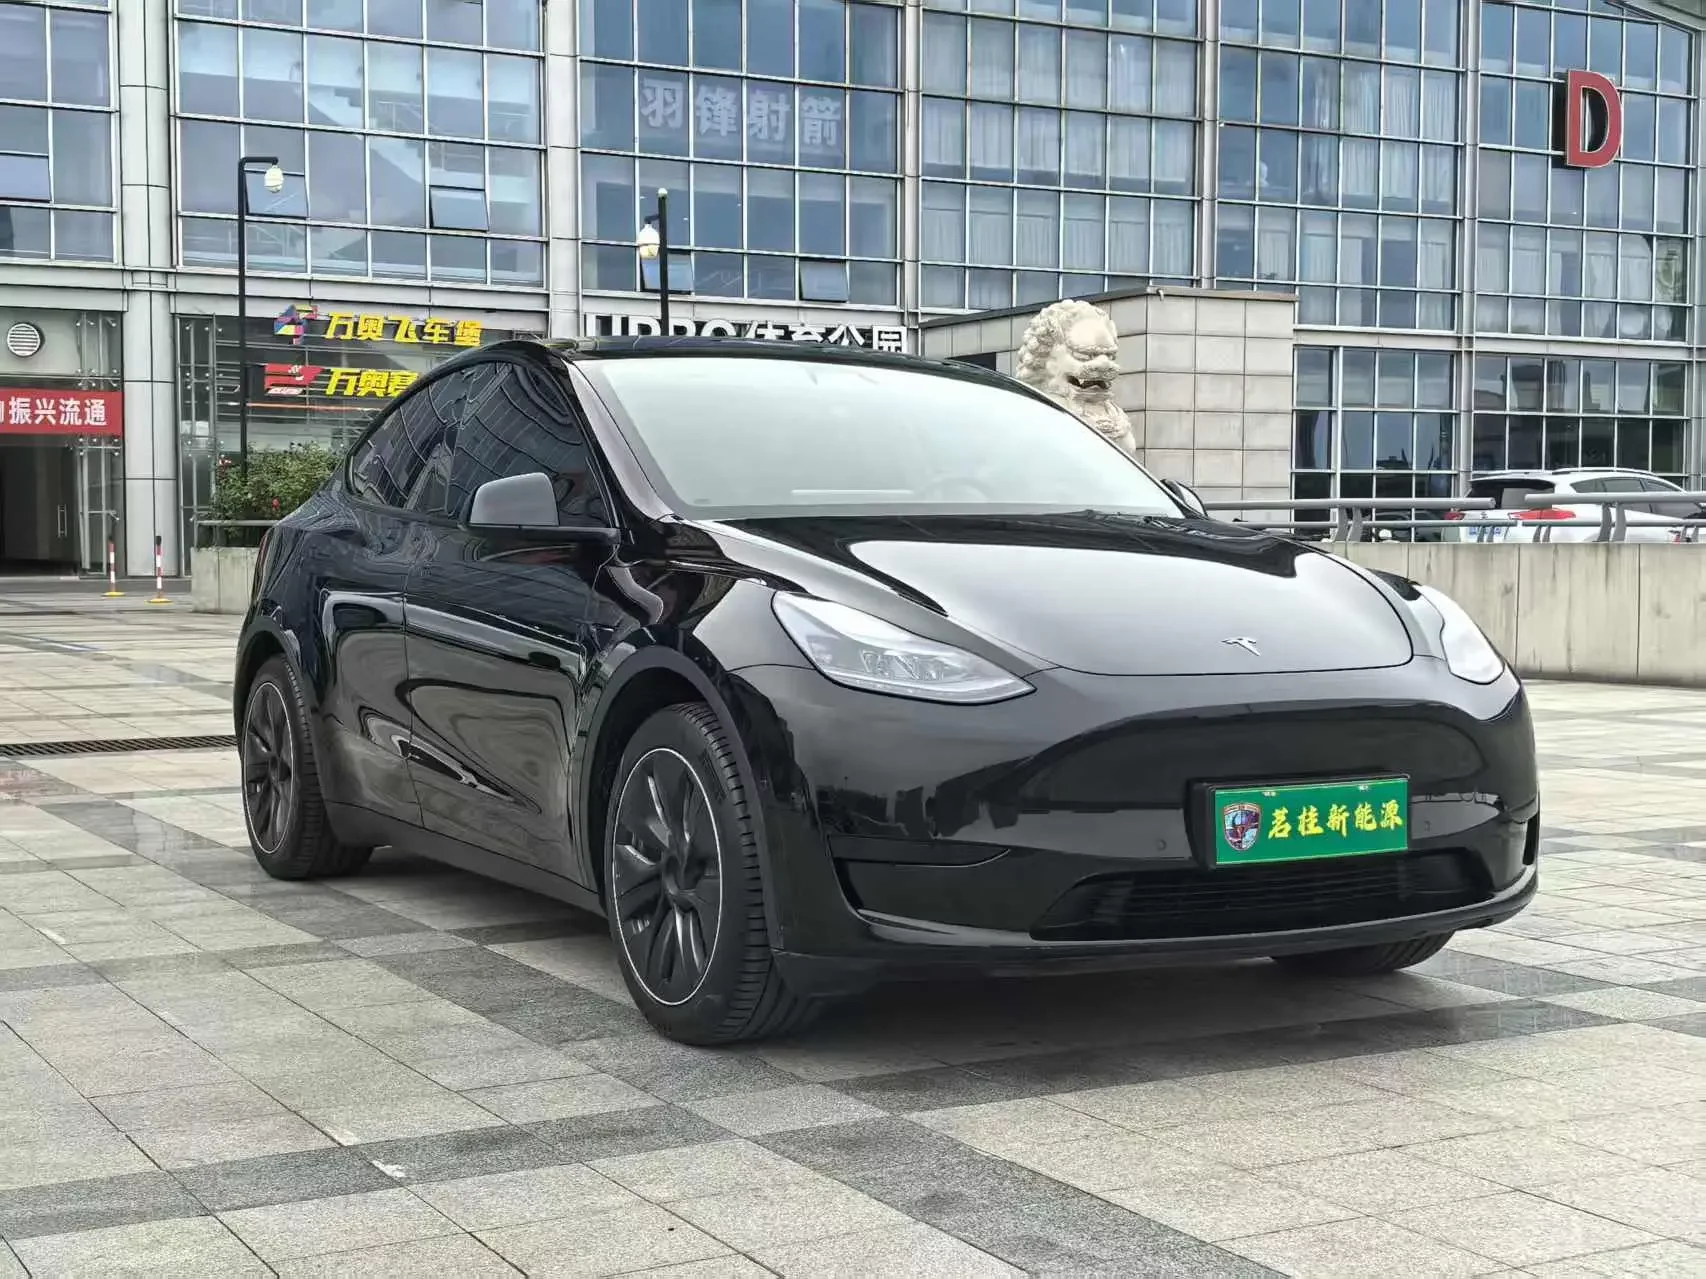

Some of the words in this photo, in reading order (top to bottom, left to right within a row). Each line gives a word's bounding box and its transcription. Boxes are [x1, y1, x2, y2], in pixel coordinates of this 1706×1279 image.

[641, 78, 842, 146] 羽锋射箭
[1565, 69, 1622, 168] D
[325, 311, 484, 347] 万奥飞车堡
[0, 396, 107, 426] 振兴流通
